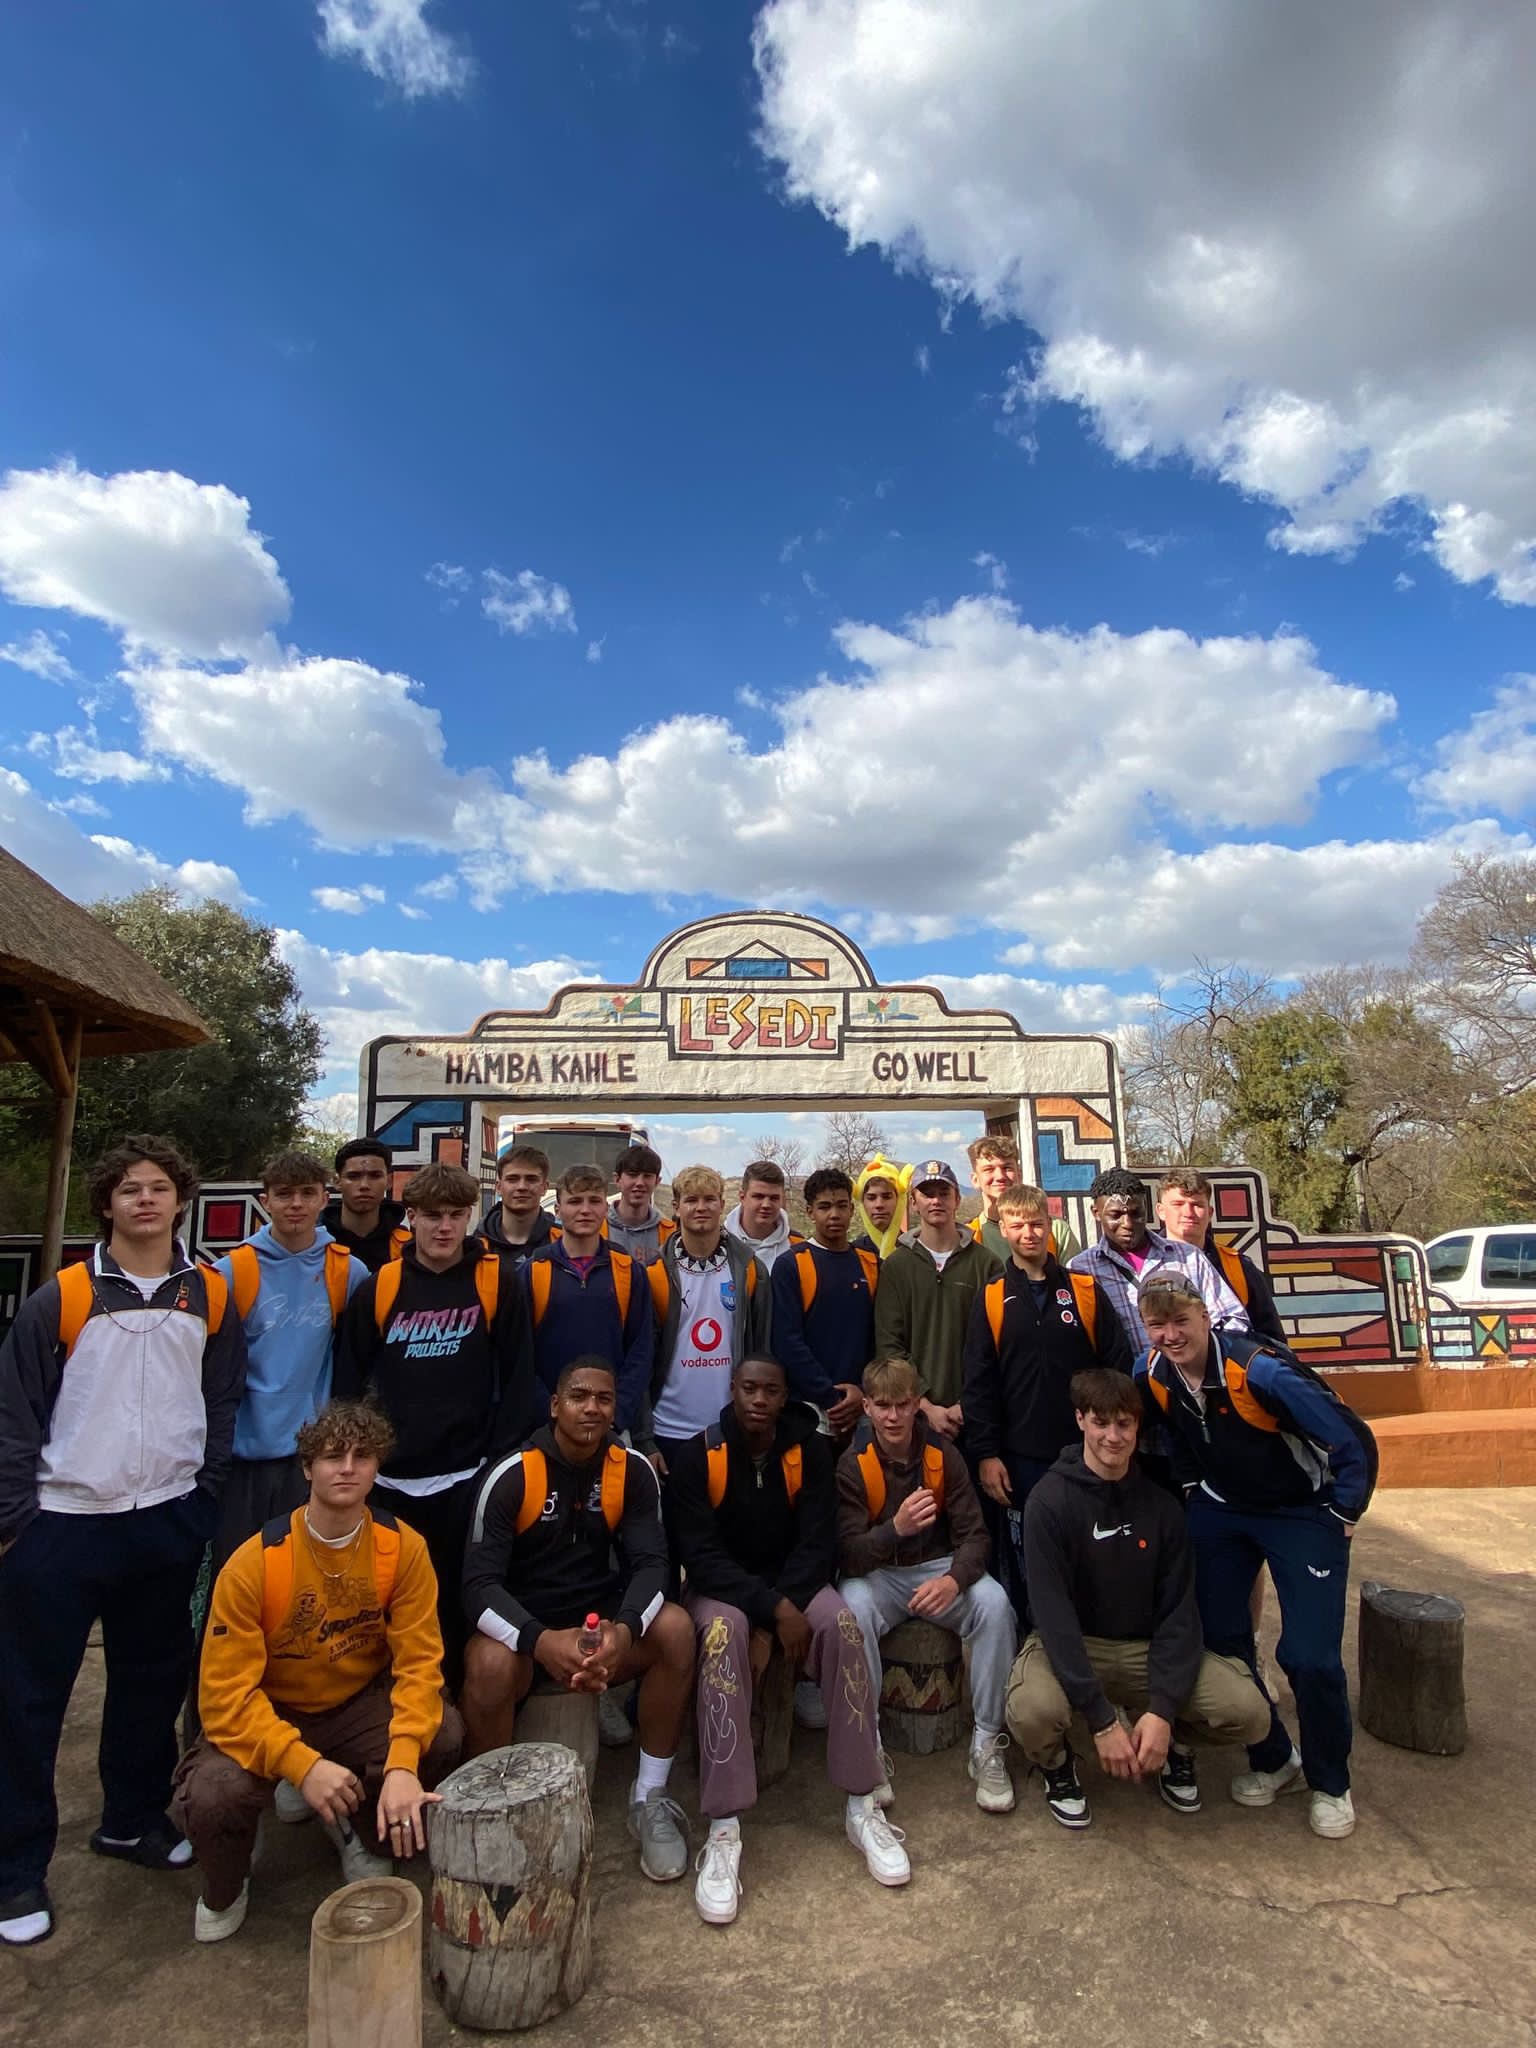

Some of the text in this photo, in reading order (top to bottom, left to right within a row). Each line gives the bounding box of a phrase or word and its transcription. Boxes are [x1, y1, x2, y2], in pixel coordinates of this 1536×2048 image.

[679, 994, 837, 1052] LESEDI
[445, 1052, 638, 1084] HAMBA KAHLE
[872, 1051, 989, 1082] GO WELL
[386, 1304, 481, 1344] WORLD
[404, 1339, 462, 1360] PROJECTS
[681, 1356, 730, 1368] vodacom
